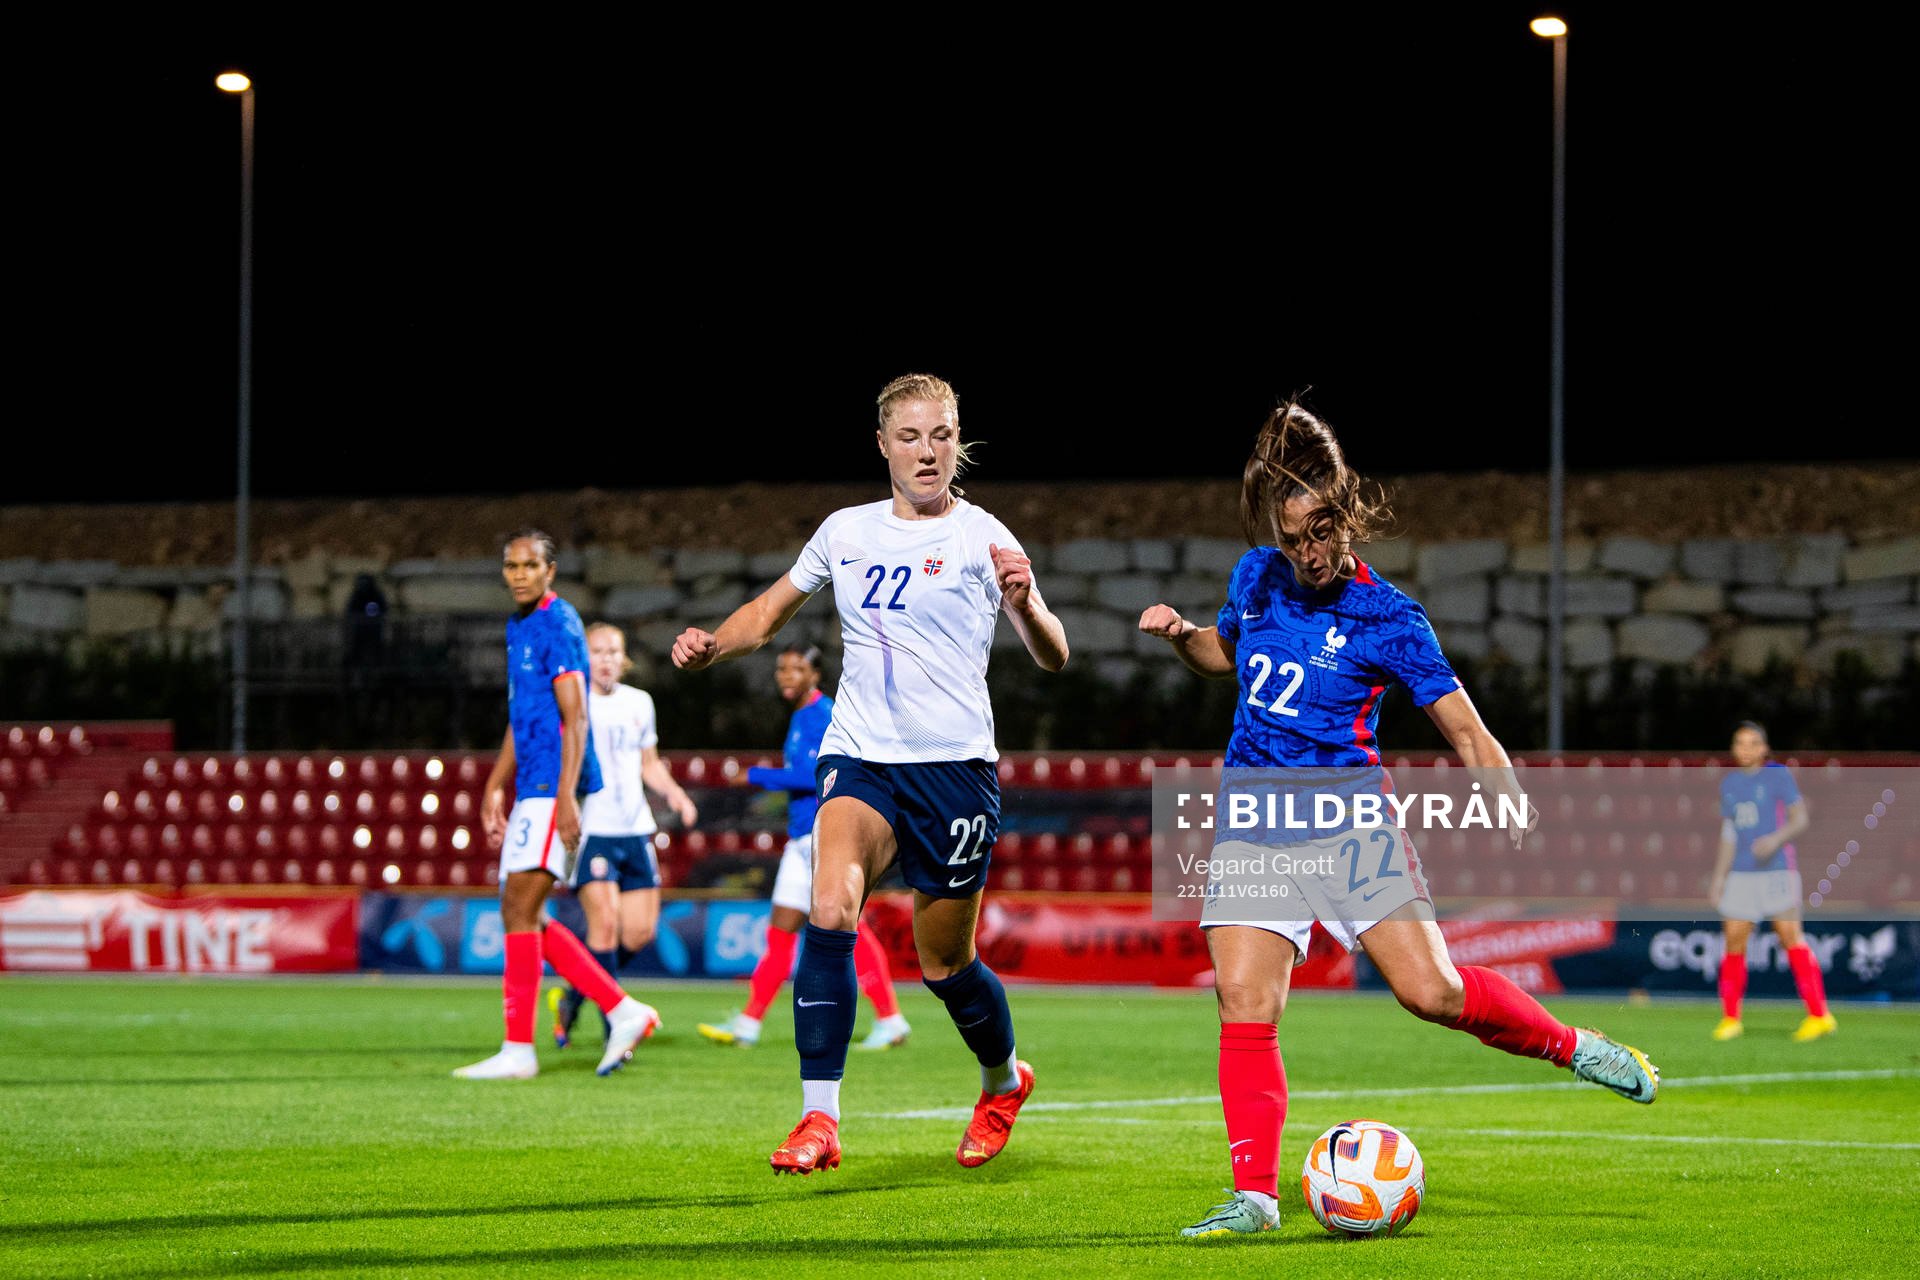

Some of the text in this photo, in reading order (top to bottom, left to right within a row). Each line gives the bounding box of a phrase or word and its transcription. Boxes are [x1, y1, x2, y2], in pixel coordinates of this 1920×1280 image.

[861, 564, 911, 610] 22
[1247, 653, 1304, 717] 22
[515, 817, 531, 846] 3
[948, 814, 987, 866] 22
[1340, 829, 1403, 894] 22
[121, 908, 274, 971] TINE
